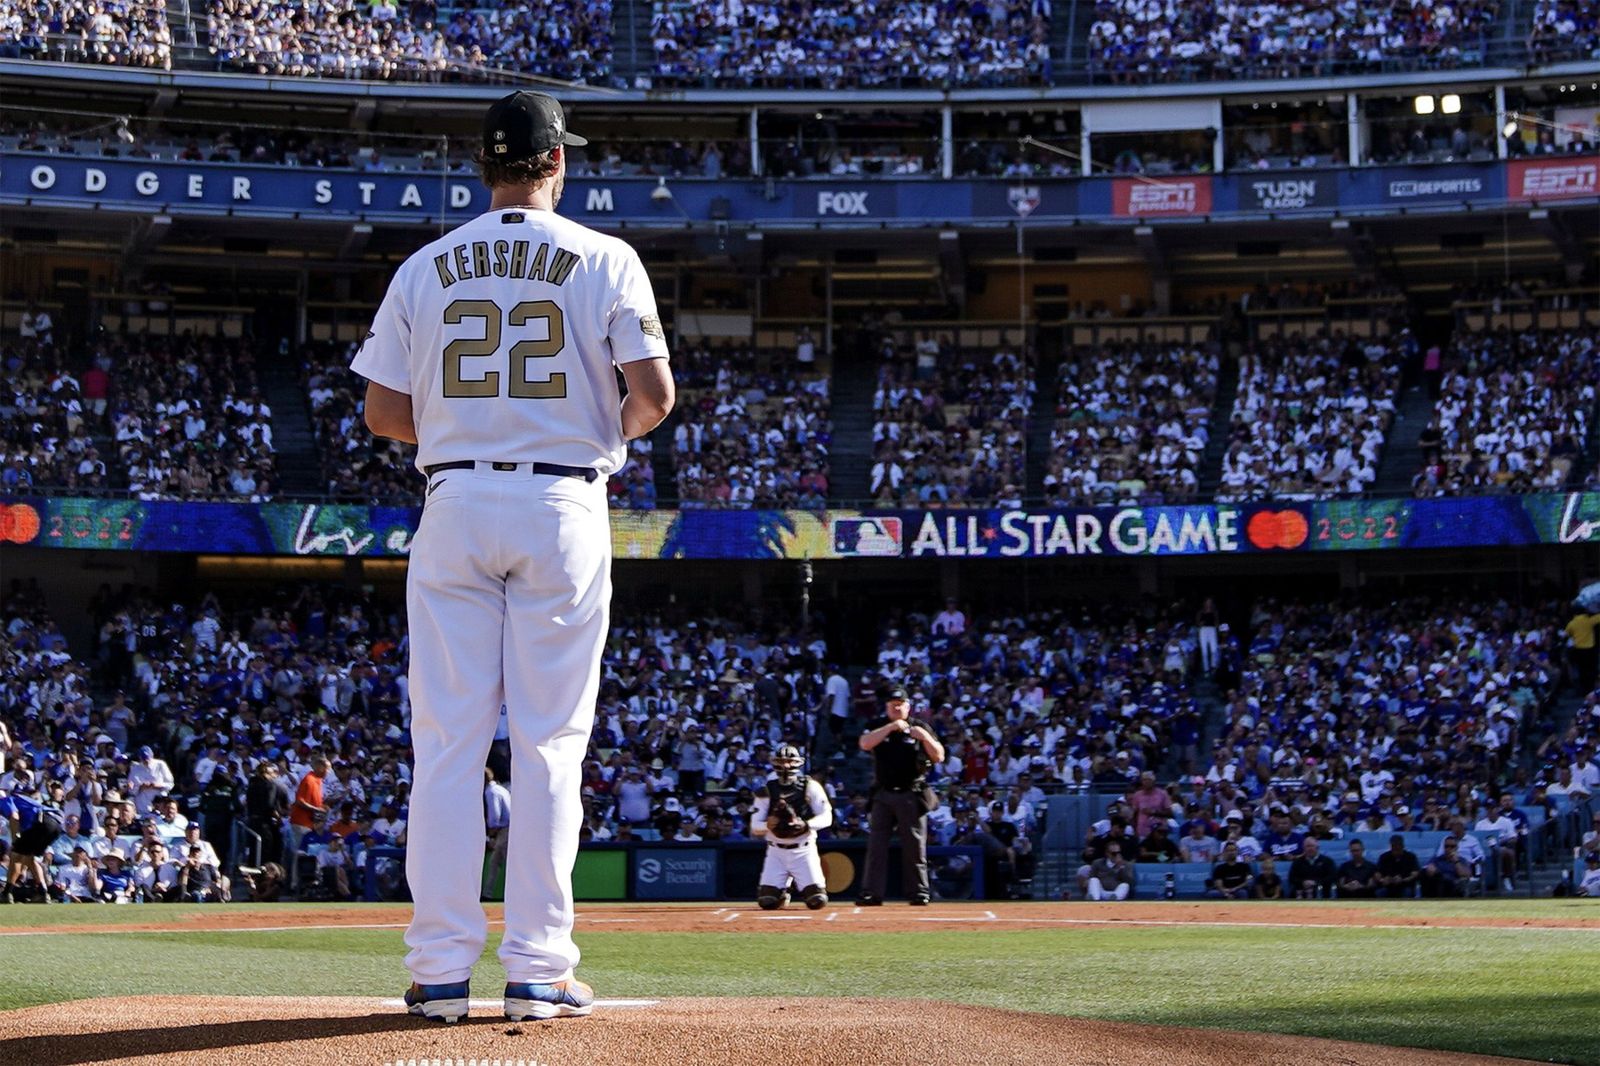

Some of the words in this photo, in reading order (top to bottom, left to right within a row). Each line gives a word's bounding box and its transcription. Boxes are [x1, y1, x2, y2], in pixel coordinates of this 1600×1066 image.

[0, 165, 252, 200] ODGER
[315, 179, 615, 212] STADM
[1419, 178, 1482, 195] DEPORTES
[1523, 164, 1597, 189] ESPN
[1130, 182, 1196, 202] ESPN
[1252, 180, 1316, 199] TUDN
[818, 191, 869, 215] FOX
[1262, 197, 1306, 209] RADIO
[434, 240, 581, 289] KERSHAW
[443, 299, 567, 399] 22
[49, 515, 133, 540] 2022
[911, 511, 988, 556] ALL
[1000, 510, 1102, 556] STAR
[1108, 508, 1239, 556] GAME
[1317, 515, 1399, 540] 2022
[665, 858, 713, 873] Security
[665, 871, 707, 884] Benefit
